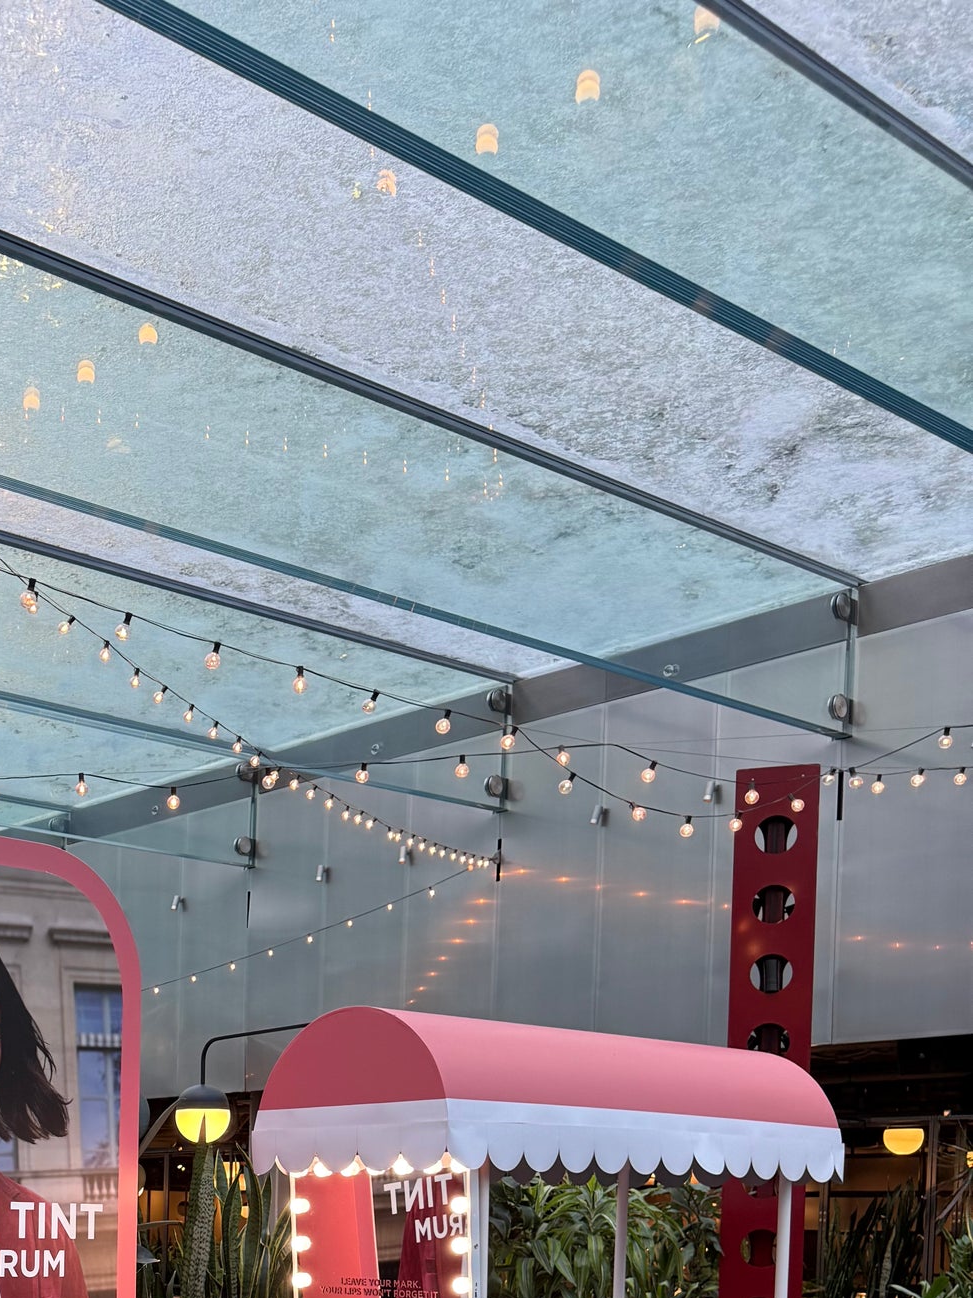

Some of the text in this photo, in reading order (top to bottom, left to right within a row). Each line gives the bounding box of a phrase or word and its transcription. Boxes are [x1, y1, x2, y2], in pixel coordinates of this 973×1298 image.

[10, 1201, 104, 1240] TINT
[341, 1277, 421, 1289] LEAVE YOUR MARK.
[321, 1285, 342, 1295] YOUR
[344, 1287, 361, 1296] LIPS
[363, 1287, 391, 1297] WON'T
[393, 1289, 429, 1298] FORGET
